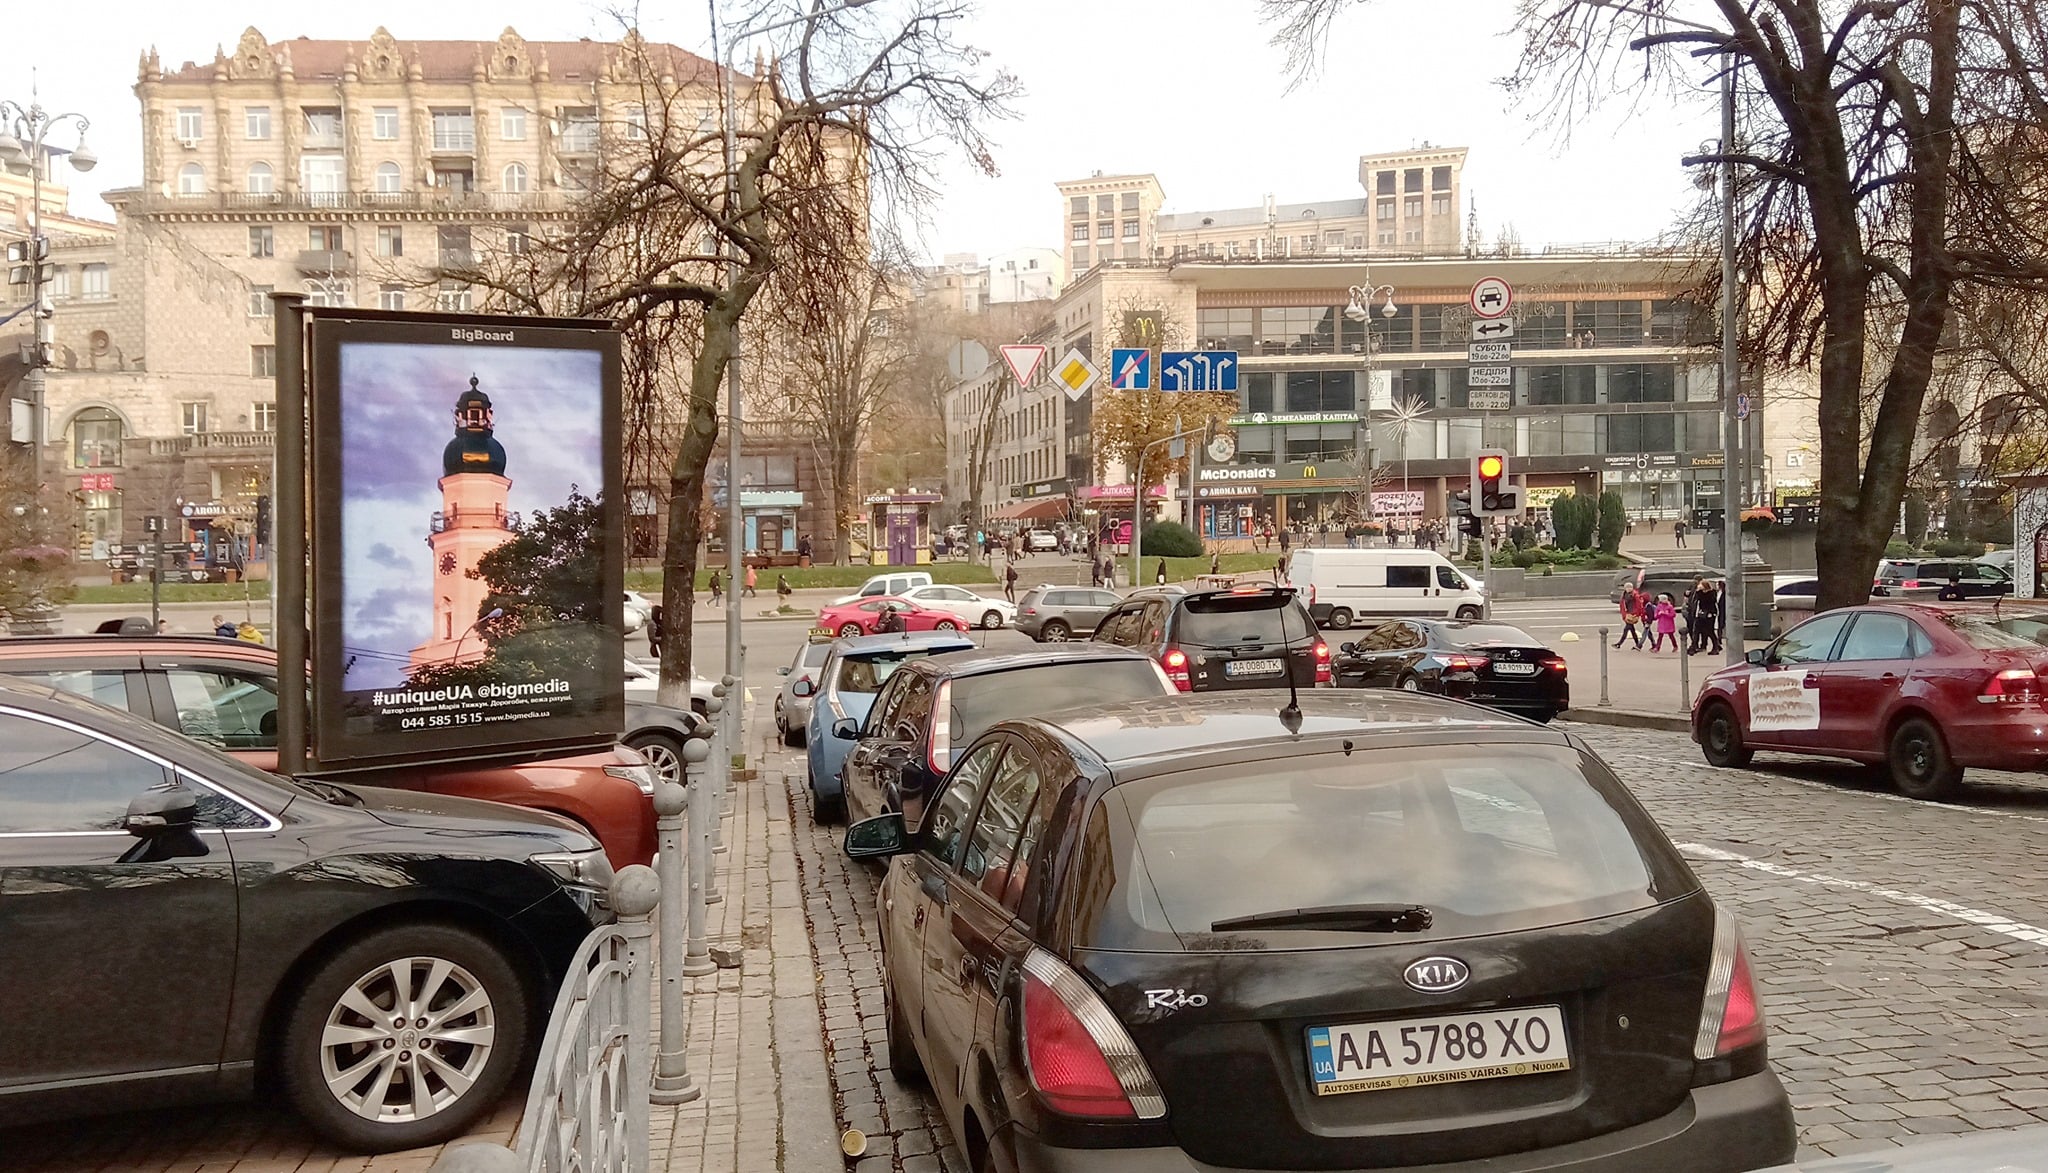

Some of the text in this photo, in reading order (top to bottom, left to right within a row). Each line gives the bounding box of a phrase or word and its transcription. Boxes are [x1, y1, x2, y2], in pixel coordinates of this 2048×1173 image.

[451, 328, 515, 342] BigBoard
[1472, 368, 1507, 376] НЕДІЛЯ
[1470, 391, 1498, 399] СВЯТКОВІ
[1271, 413, 1359, 422] ЗЕМЕЛЬНИЙ КАПІТАЛ
[1691, 457, 1725, 465] Kreschat
[1787, 453, 1804, 466] EY
[1200, 468, 1277, 481] McDonald's
[1208, 486, 1258, 497] AROMA KAVA
[194, 506, 227, 515] AROMA
[1232, 662, 1245, 672] AA
[1267, 659, 1280, 669] TK
[372, 678, 570, 706] #uniqueUA @bigmedia
[438, 703, 461, 711] Марія
[401, 710, 551, 729] 044 585 15 15 www.bigmedia.ua
[1414, 964, 1460, 985] KIA
[1144, 988, 1209, 1011] Rio
[1337, 1016, 1551, 1072] AA 5788 XO
[1315, 1061, 1334, 1075] UA
[1416, 1069, 1468, 1085] AUKSINIS
[1470, 1066, 1509, 1079] VAIRAS
